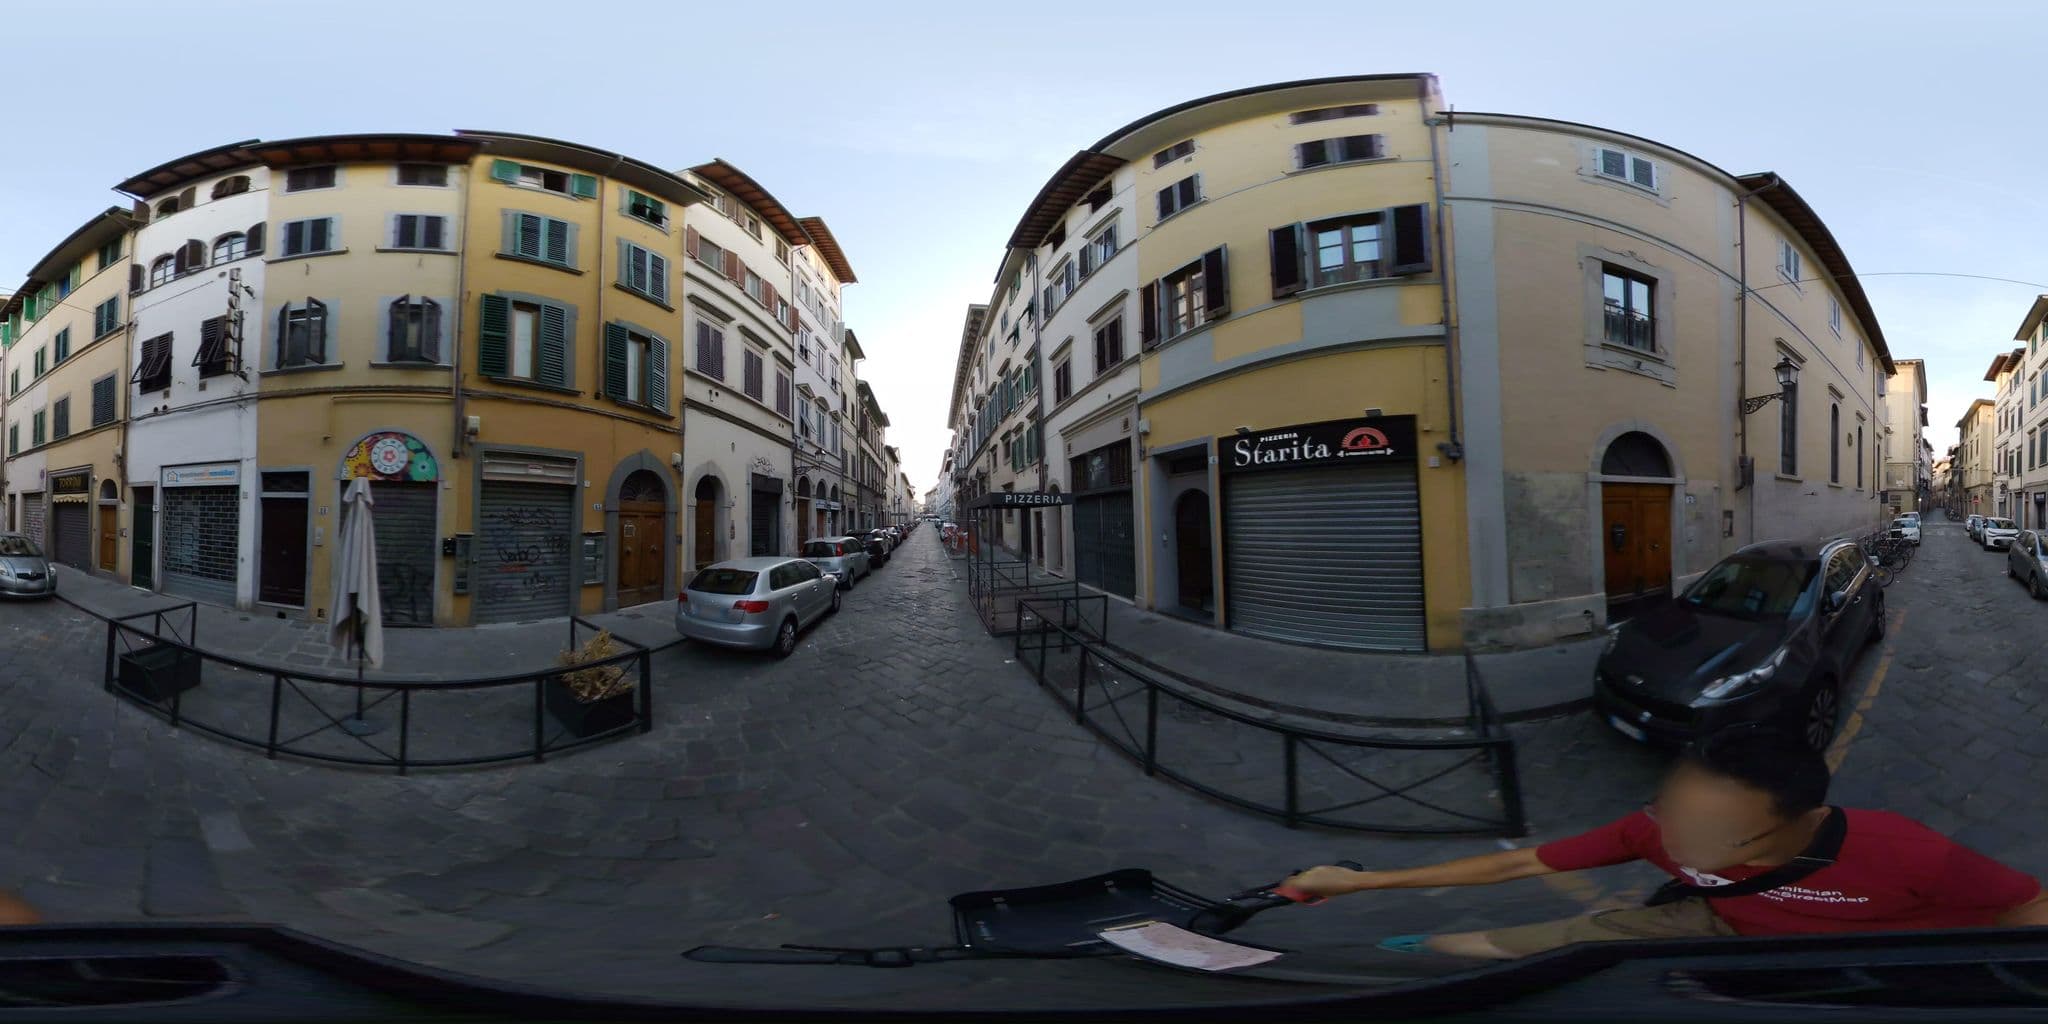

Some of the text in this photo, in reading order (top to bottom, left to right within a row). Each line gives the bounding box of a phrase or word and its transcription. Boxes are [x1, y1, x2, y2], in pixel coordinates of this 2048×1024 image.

[1260, 432, 1298, 442] PIZZERIA
[1234, 436, 1332, 467] Starita
[1005, 494, 1063, 505] PIZZERIA
